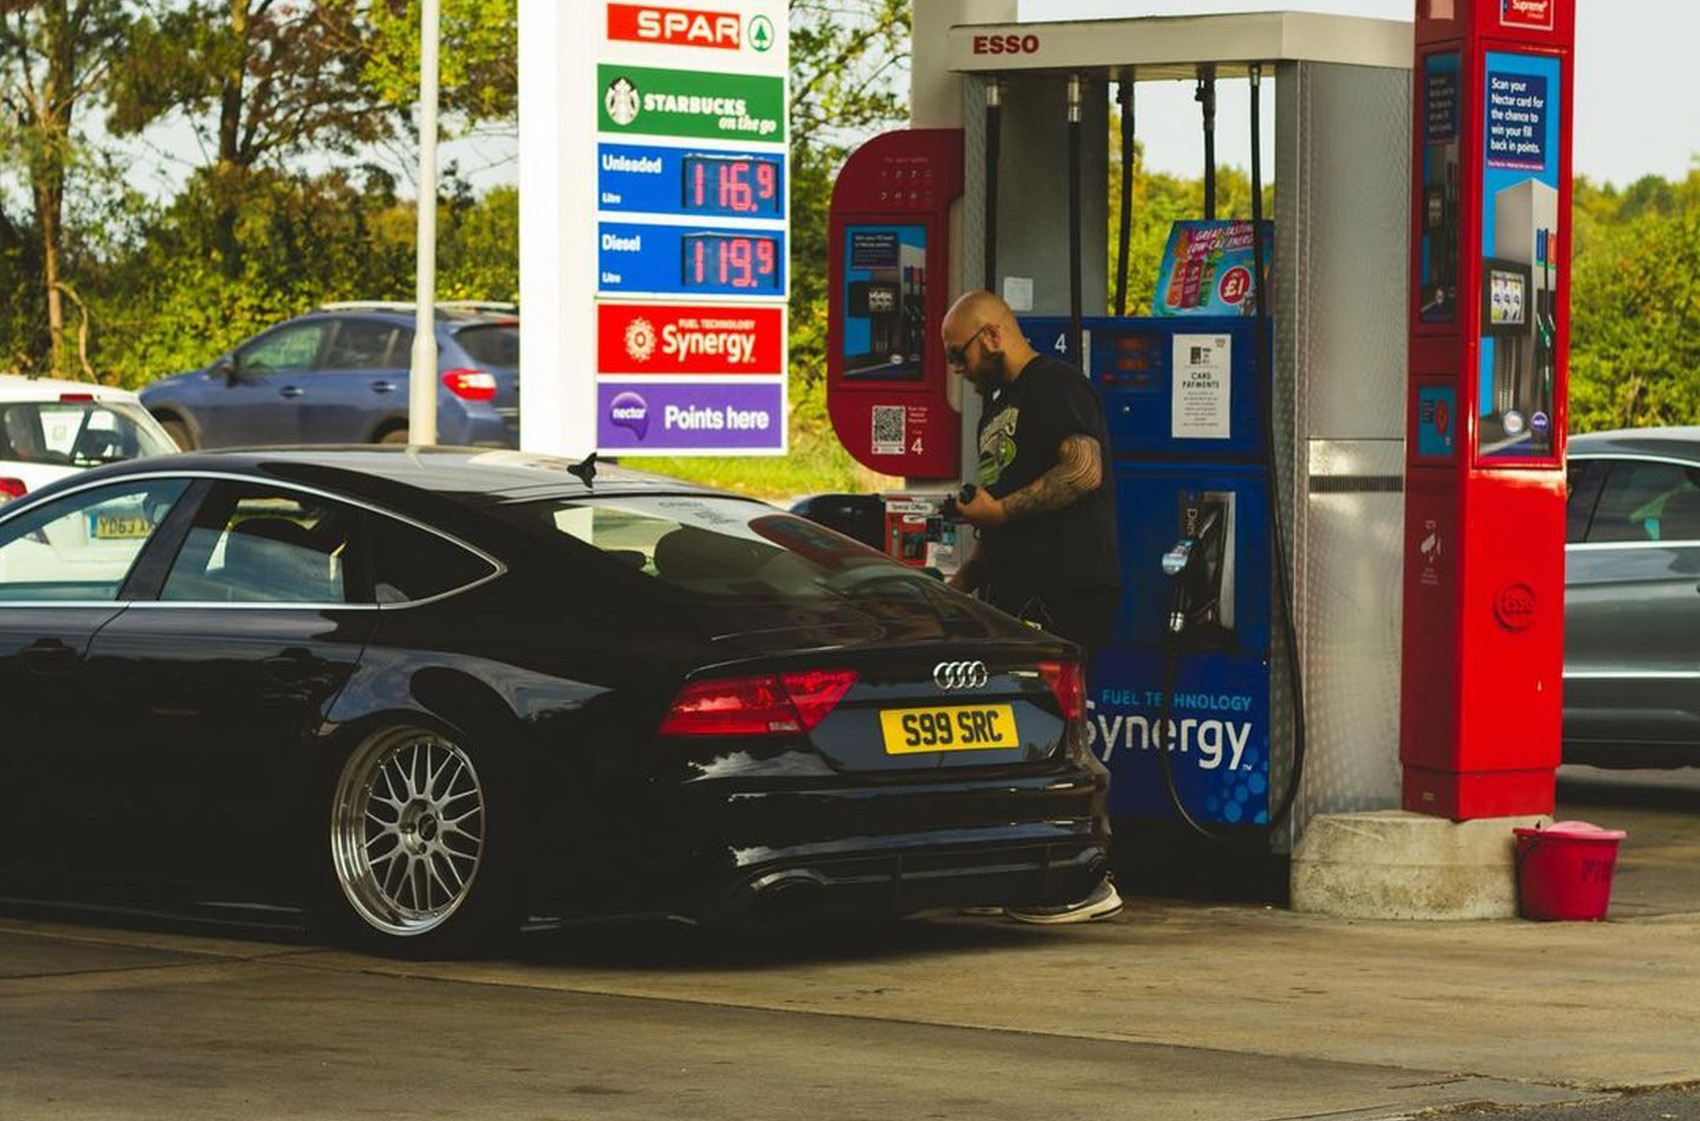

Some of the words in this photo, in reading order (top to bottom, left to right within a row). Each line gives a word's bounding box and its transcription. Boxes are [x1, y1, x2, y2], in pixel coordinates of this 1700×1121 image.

[636, 10, 739, 44] SPAR
[973, 34, 1039, 55] ESSO
[1491, 77, 1509, 90] Scan
[1510, 82, 1527, 93] your
[643, 93, 747, 116] STARBUCKS
[1491, 93, 1516, 106] Nectar
[1516, 96, 1532, 107] card
[1532, 95, 1544, 108] for
[718, 117, 736, 130] on
[738, 114, 759, 131] the
[759, 119, 777, 135] go
[1491, 108, 1504, 120] the
[1504, 109, 1529, 122] chance
[1530, 112, 1539, 123] to
[1491, 123, 1504, 135] win
[1505, 127, 1521, 139] your
[1490, 138, 1507, 151] back
[1508, 139, 1517, 151] in
[602, 154, 662, 174] Unleaded
[602, 234, 641, 251] Diesel
[602, 272, 621, 284] Litre
[1223, 278, 1244, 297] £1
[678, 318, 699, 330] FUEL
[701, 319, 756, 330] TECHNOLOGY
[662, 324, 756, 363] Synergy
[1054, 333, 1067, 353] 4
[1182, 381, 1219, 389] PAYMENTS
[612, 407, 646, 420] nectar
[664, 405, 723, 430] Points
[726, 405, 769, 430] here
[911, 437, 924, 455] 4
[100, 518, 135, 534] YD63
[1102, 688, 1140, 705] FUEL
[1146, 692, 1252, 710] TEHNOLOGY
[902, 712, 954, 746] S99
[957, 710, 1003, 743] SRC
